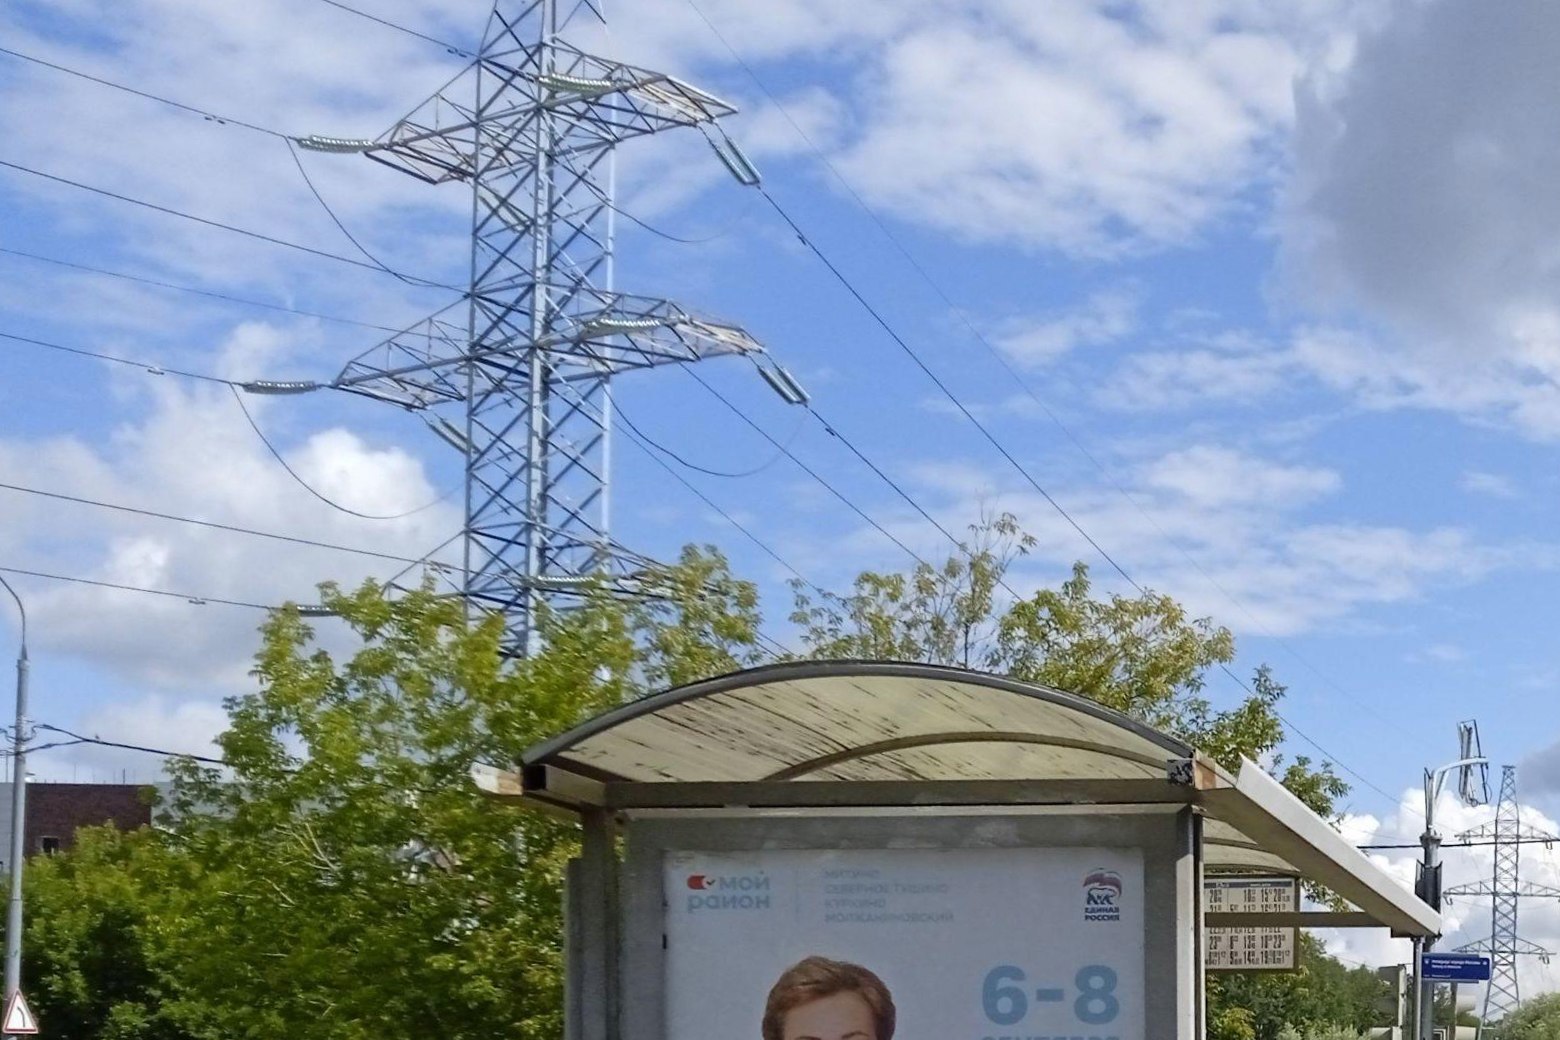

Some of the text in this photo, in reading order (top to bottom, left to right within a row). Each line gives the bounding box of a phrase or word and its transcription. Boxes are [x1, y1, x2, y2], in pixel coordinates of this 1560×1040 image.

[719, 870, 769, 890] мой
[1084, 906, 1120, 914] ЕДИНАЯ
[1084, 914, 1120, 922] РОССИЯ
